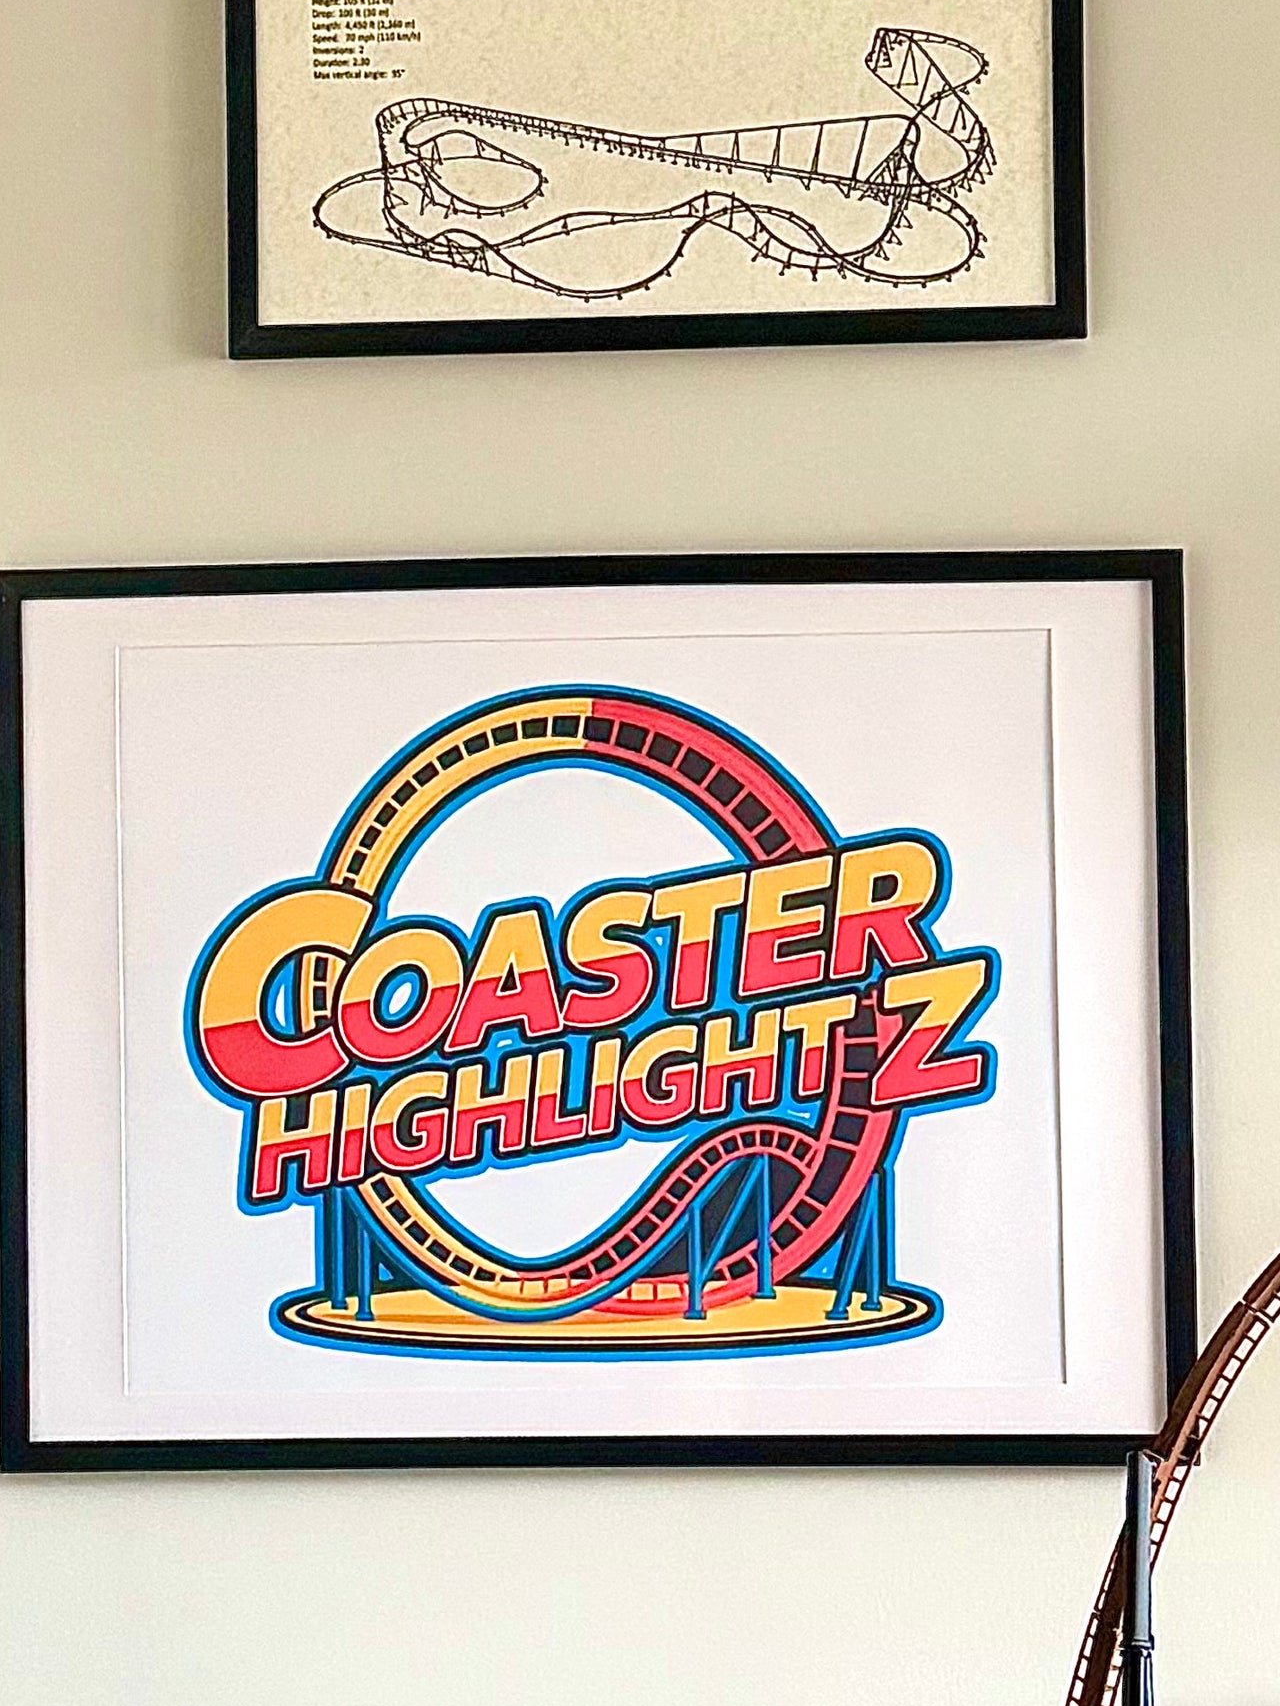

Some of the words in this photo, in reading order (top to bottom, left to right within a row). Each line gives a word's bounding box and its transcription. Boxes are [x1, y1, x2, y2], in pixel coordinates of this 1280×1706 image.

[312, 22, 341, 32] Length:
[333, 70, 361, 79] vertical
[199, 840, 938, 1098] COASTER
